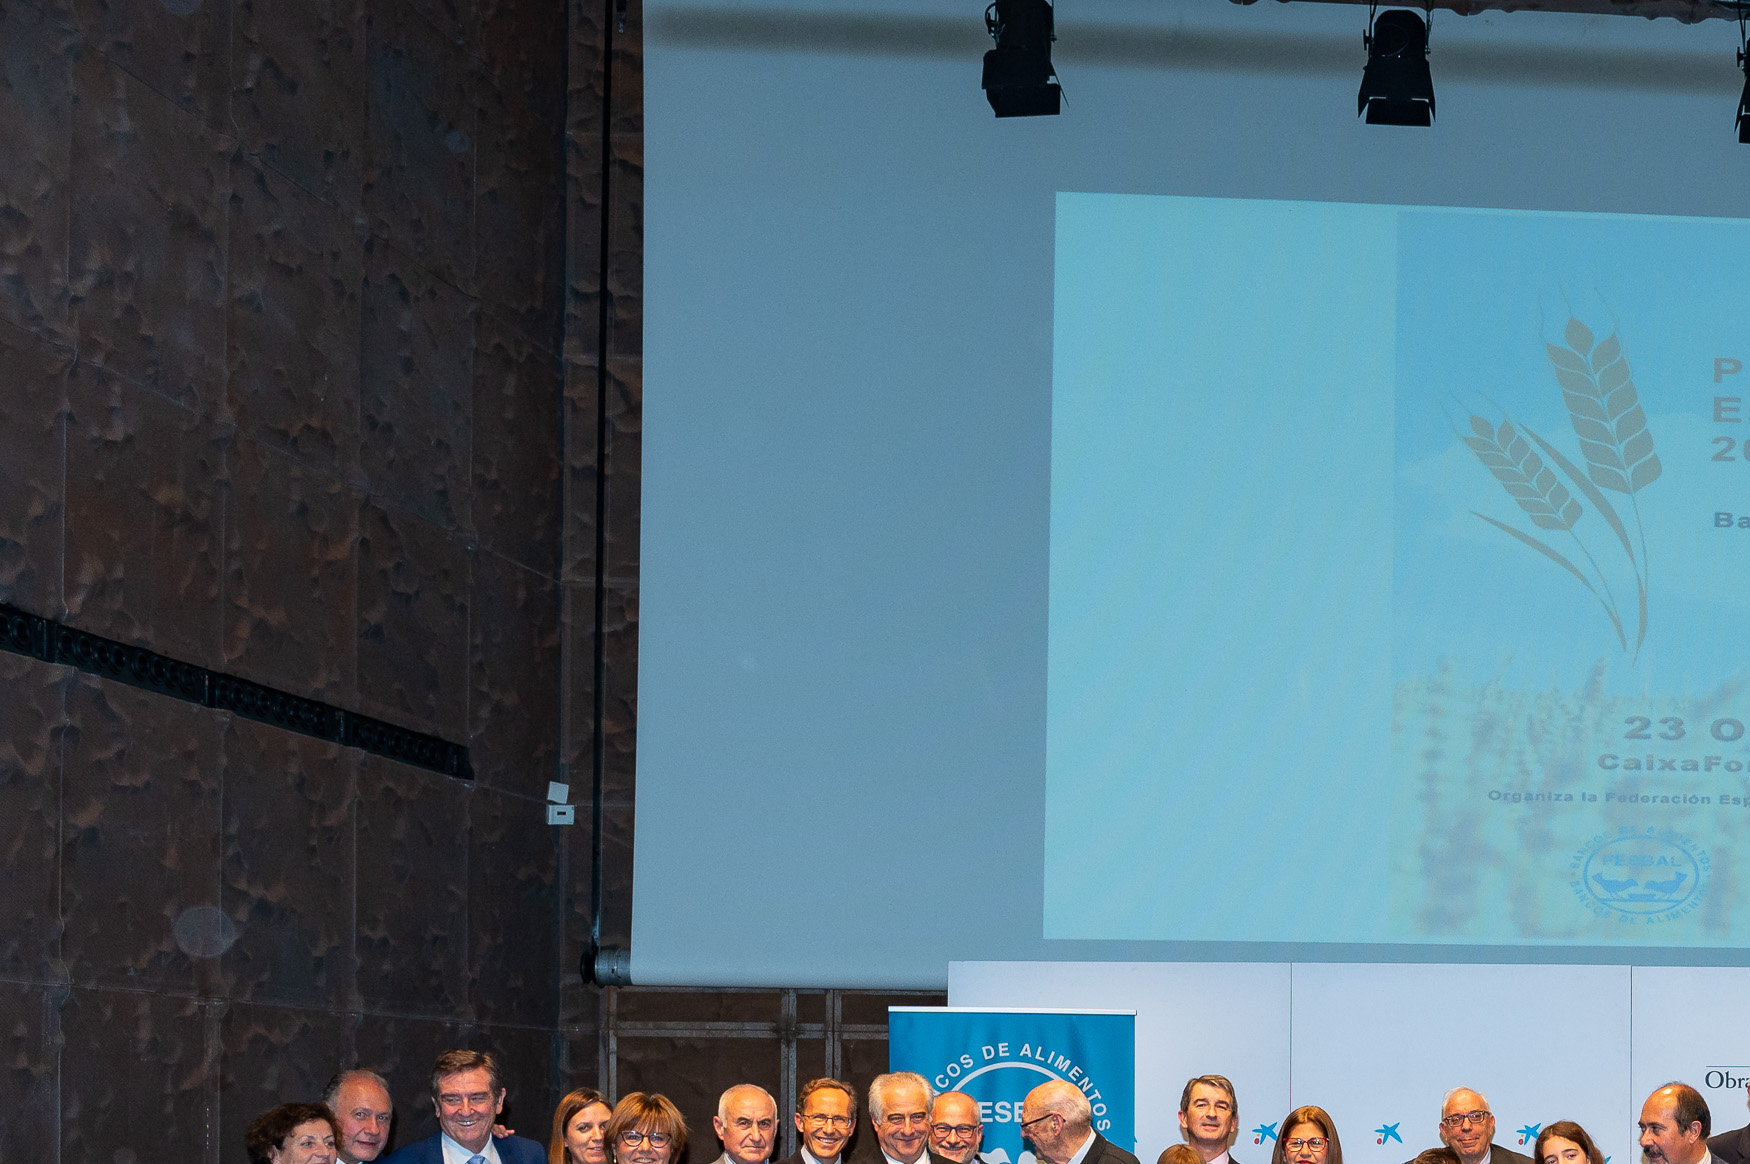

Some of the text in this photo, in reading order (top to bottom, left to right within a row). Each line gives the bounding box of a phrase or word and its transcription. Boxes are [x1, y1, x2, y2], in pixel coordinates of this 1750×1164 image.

[1623, 715, 1687, 741] 23
[1488, 789, 1574, 804] Organiza
[1581, 791, 1597, 802] la
[1605, 791, 1711, 805] Federación
[981, 1042, 1010, 1061] DE
[1019, 1043, 1112, 1132] ALIMENTOS
